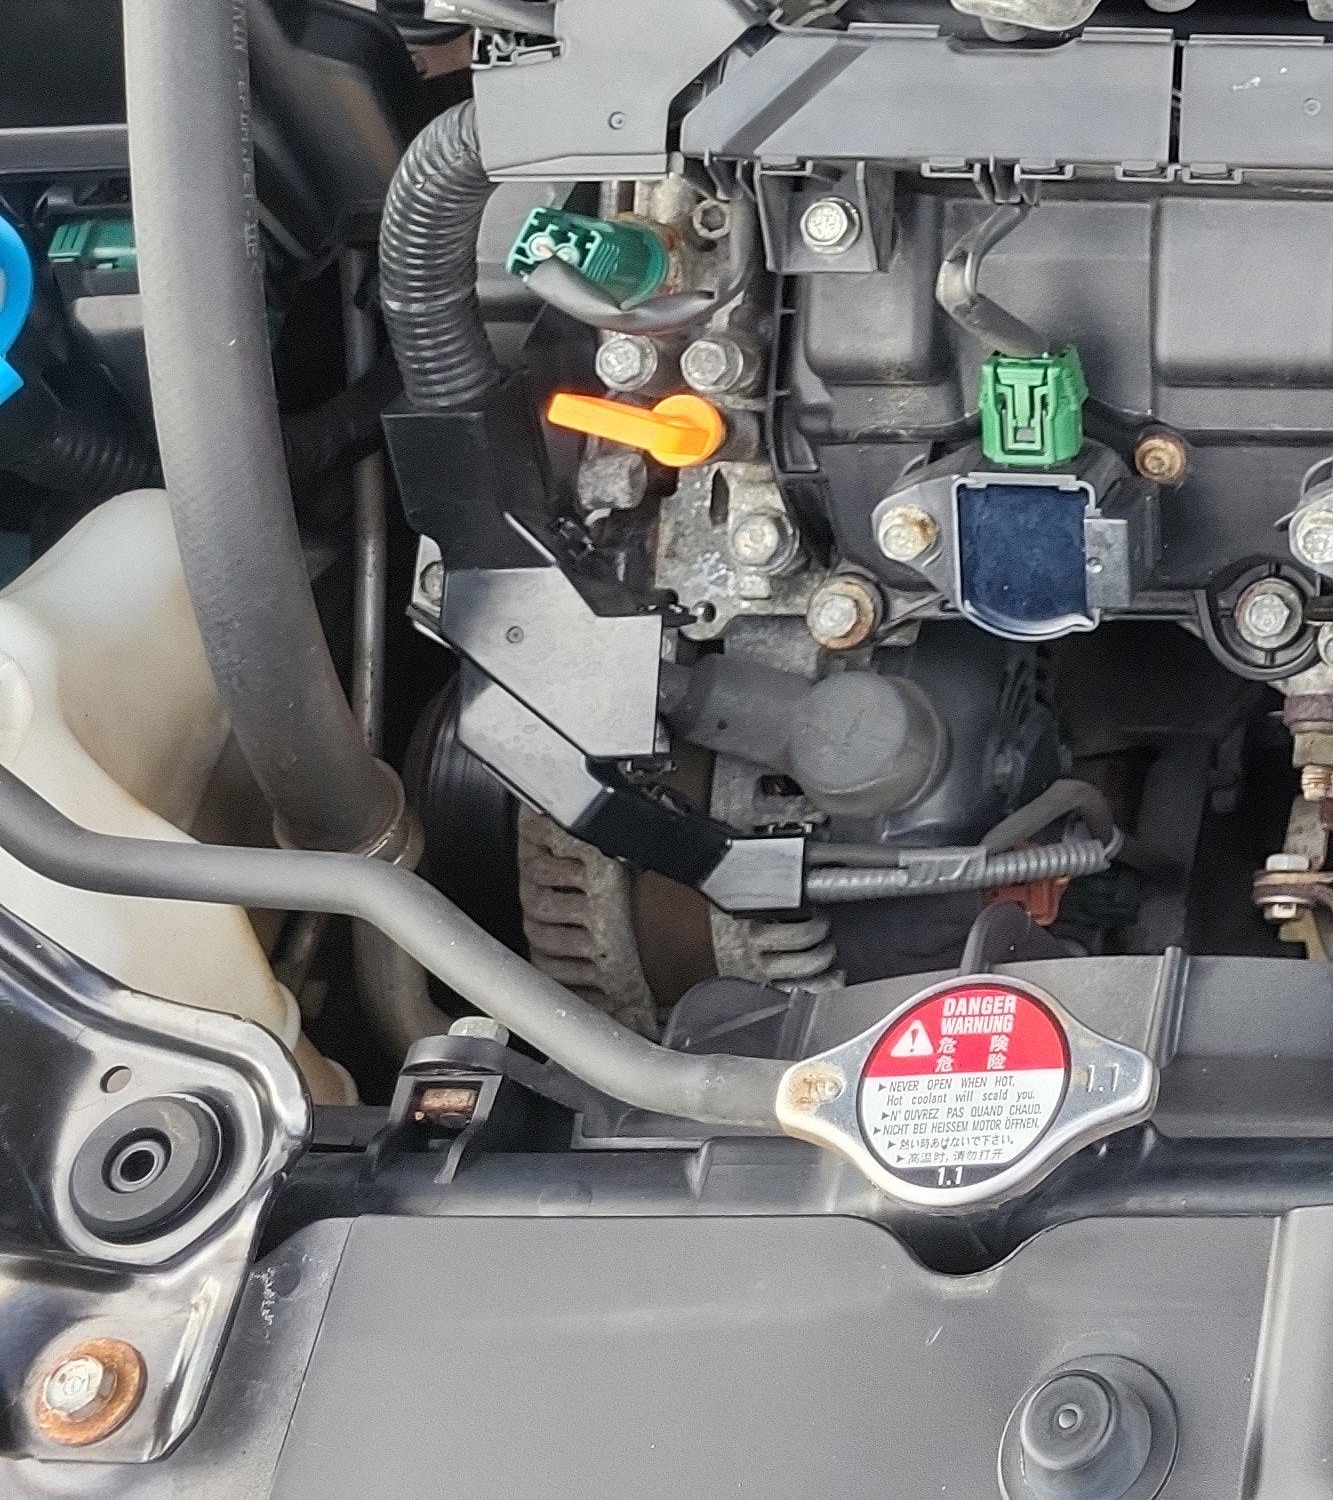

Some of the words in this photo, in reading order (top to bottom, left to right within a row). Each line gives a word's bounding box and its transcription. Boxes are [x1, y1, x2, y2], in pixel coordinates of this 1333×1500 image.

[943, 995, 1017, 1017] DANGER
[940, 1015, 1015, 1037] WARNUNG
[889, 1080, 920, 1092] NEVER
[927, 1078, 953, 1090] OPEN
[961, 1076, 988, 1089] WHEN
[886, 1094, 903, 1106] Hot
[911, 1092, 947, 1105] coolant
[955, 1090, 974, 1103] will
[982, 1088, 1009, 1101] scald
[1016, 1090, 1036, 1103] you.
[904, 1108, 939, 1121] OUVREZ
[946, 1106, 965, 1119] PAS
[970, 1105, 1004, 1118] QUAND
[1009, 1103, 1042, 1116] CHAUD.
[883, 1123, 910, 1136] NICHT
[913, 1122, 928, 1135] BEI
[931, 1120, 969, 1133] HEISSEM
[972, 1119, 1002, 1132] MOTOR
[1004, 1116, 1041, 1130] ÖFFNEN.
[937, 1165, 964, 1186] 1.1
